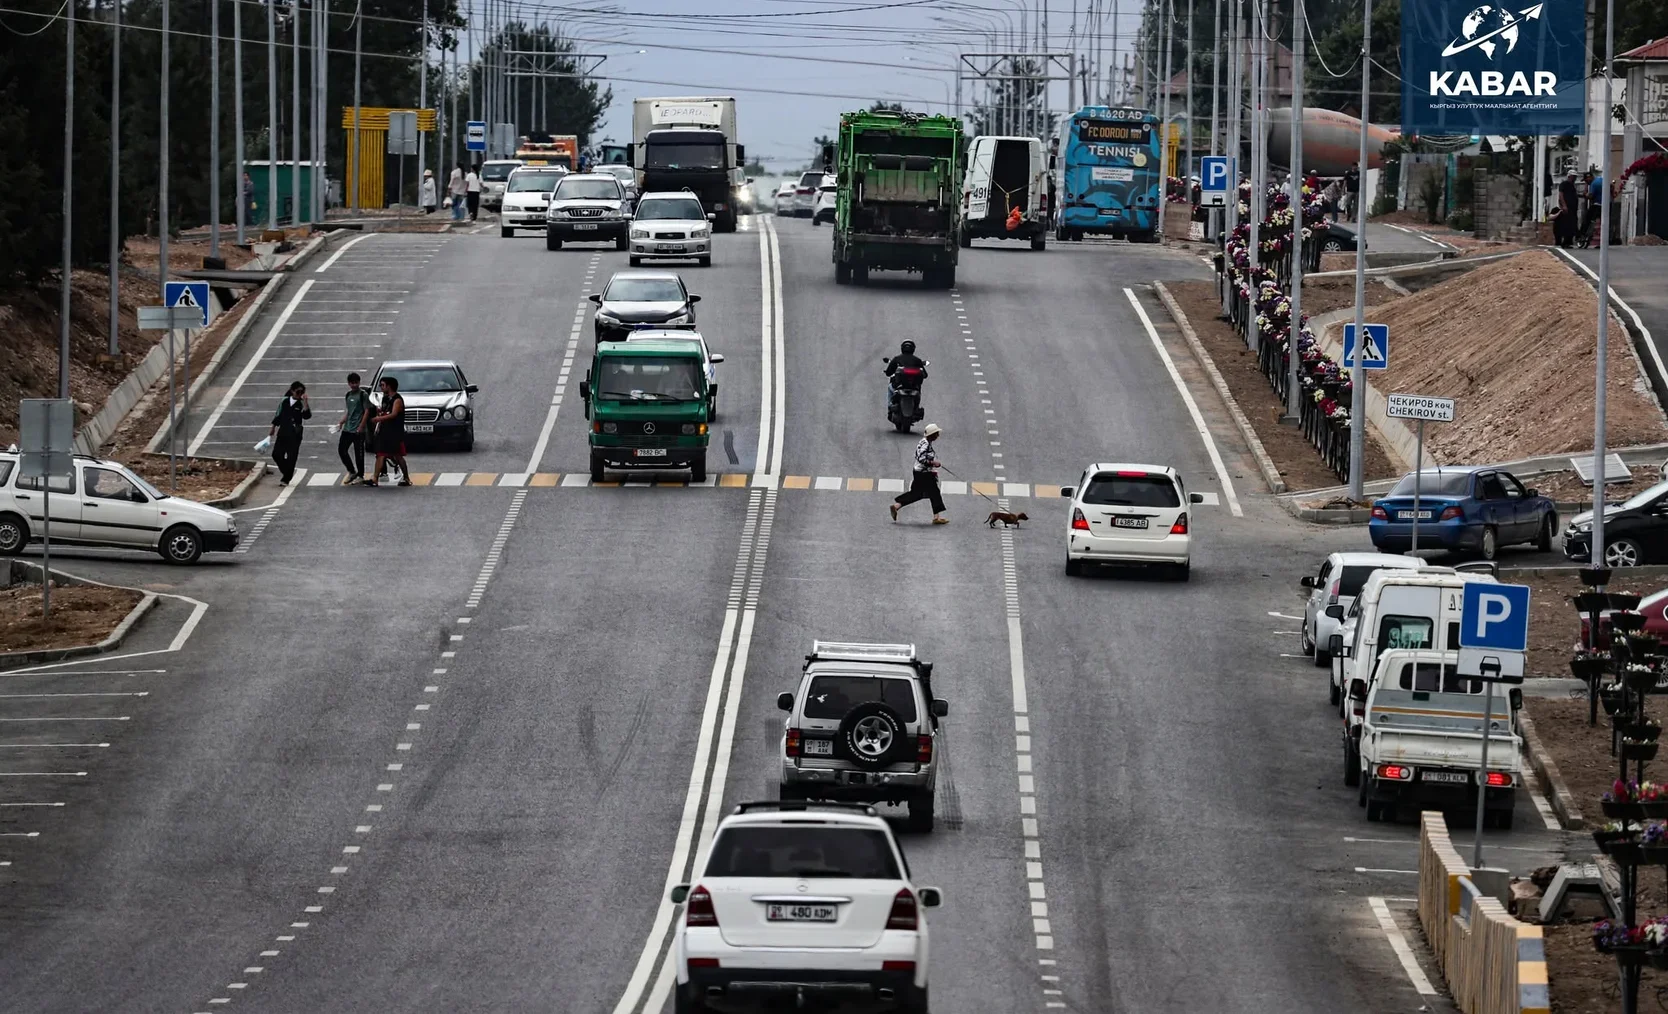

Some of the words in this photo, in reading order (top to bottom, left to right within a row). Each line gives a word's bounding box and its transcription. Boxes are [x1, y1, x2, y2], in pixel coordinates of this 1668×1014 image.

[1099, 110, 1126, 119] 4620
[1127, 111, 1143, 120] AD
[1088, 126, 1099, 137] FC
[1210, 162, 1227, 186] P
[1391, 397, 1433, 408] ЧЕКИРОВ
[1389, 407, 1436, 418] CHEKIROV
[1438, 411, 1449, 419] st.
[1477, 593, 1511, 638] P
[790, 907, 812, 919] 480
